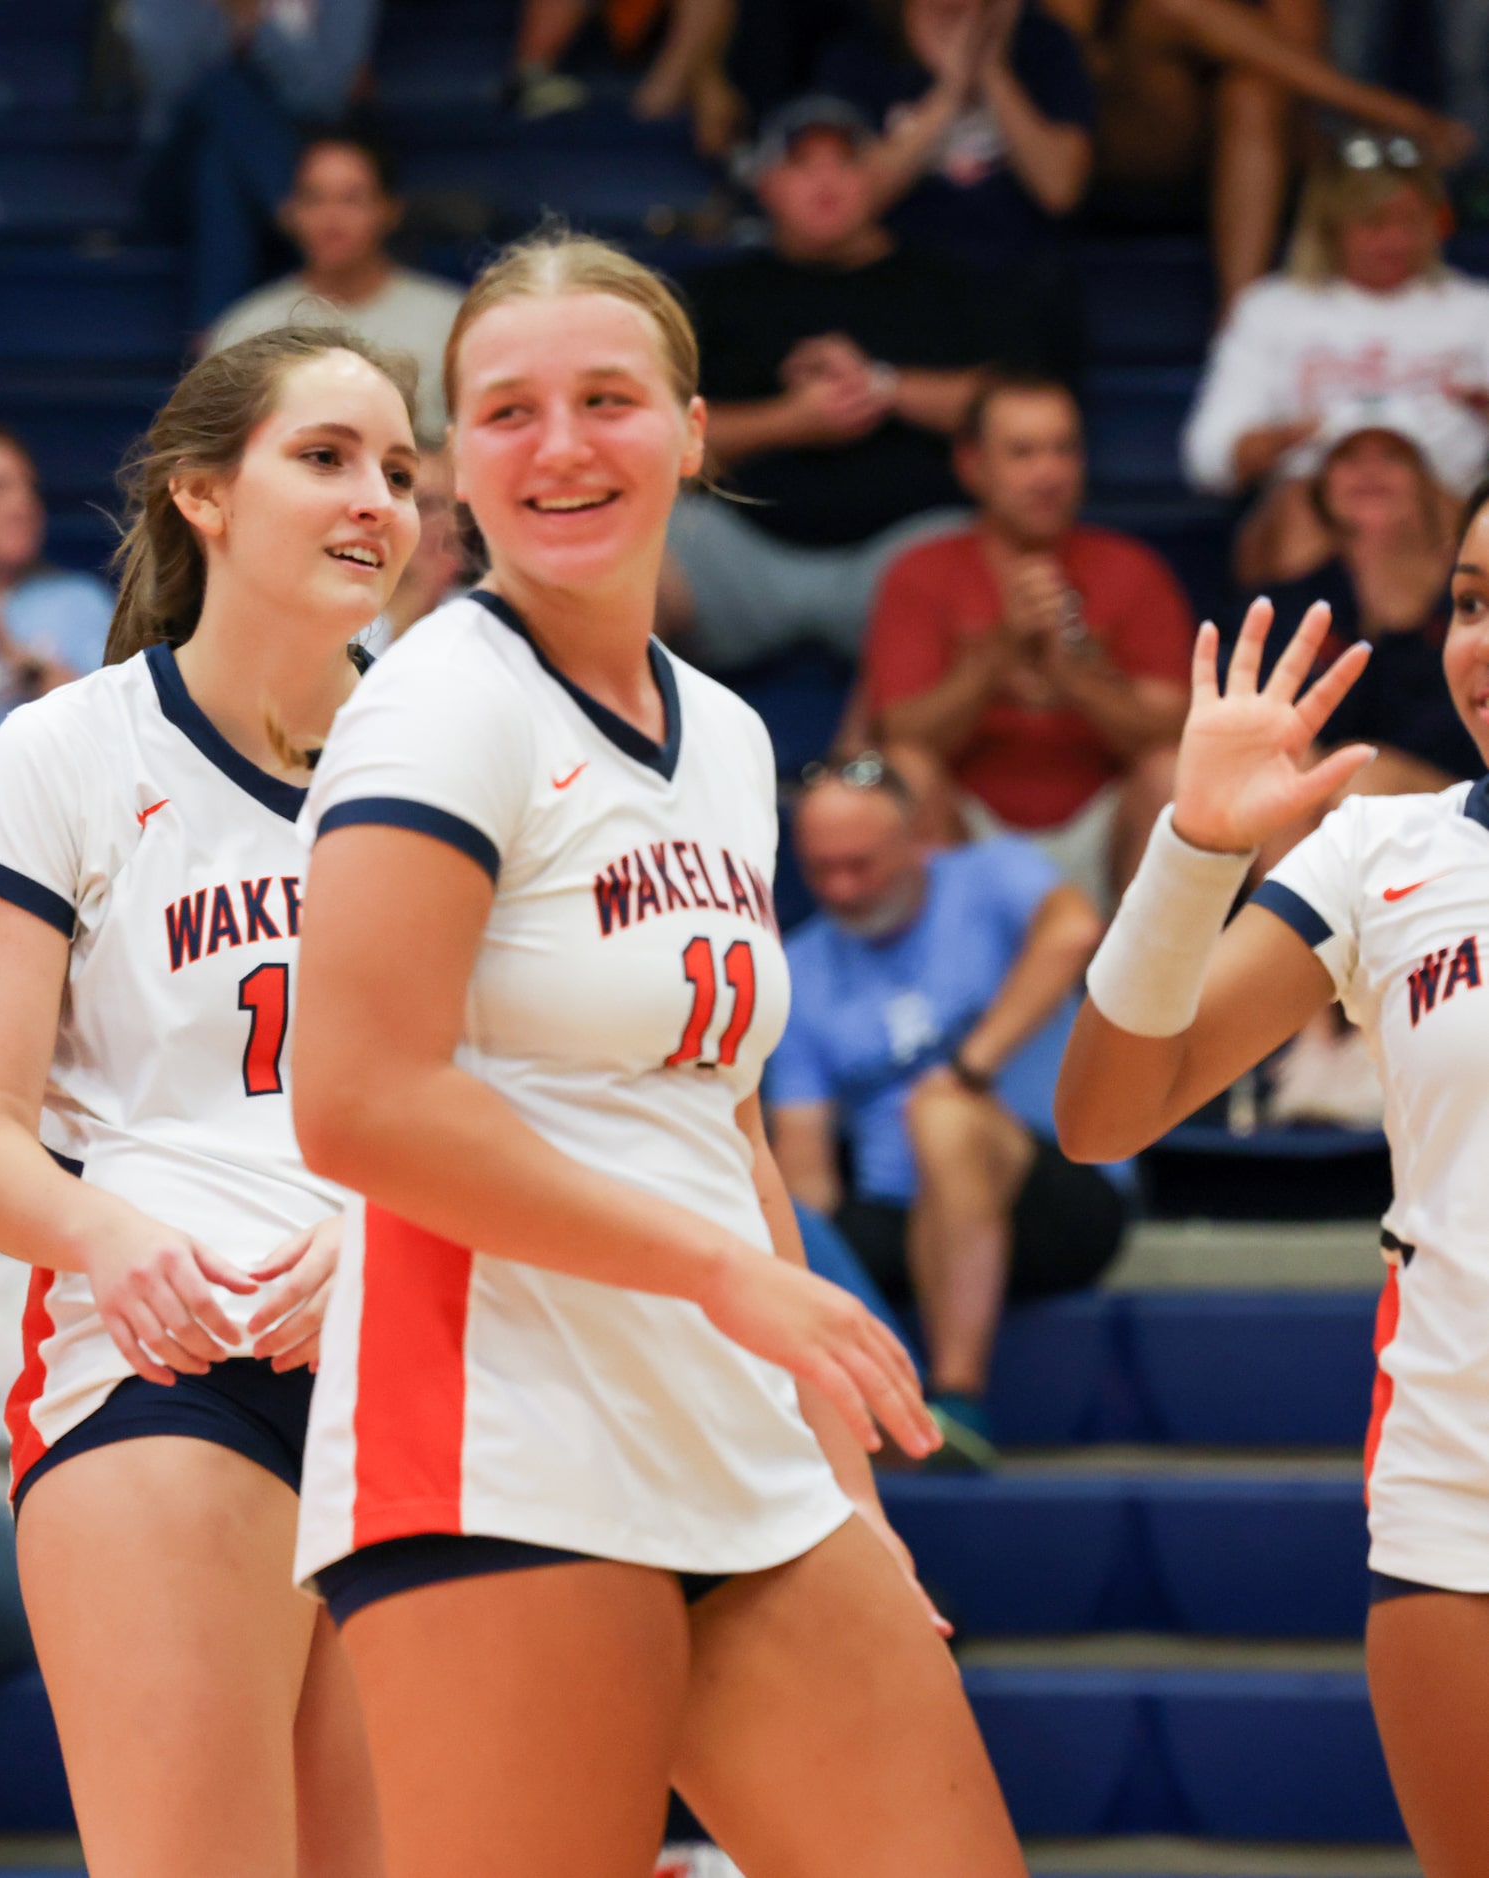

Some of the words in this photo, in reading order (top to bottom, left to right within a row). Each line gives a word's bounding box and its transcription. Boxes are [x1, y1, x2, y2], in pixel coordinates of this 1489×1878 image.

[238, 963, 288, 1097] 1
[664, 936, 756, 1069] 11
[1407, 934, 1483, 1030] WA
